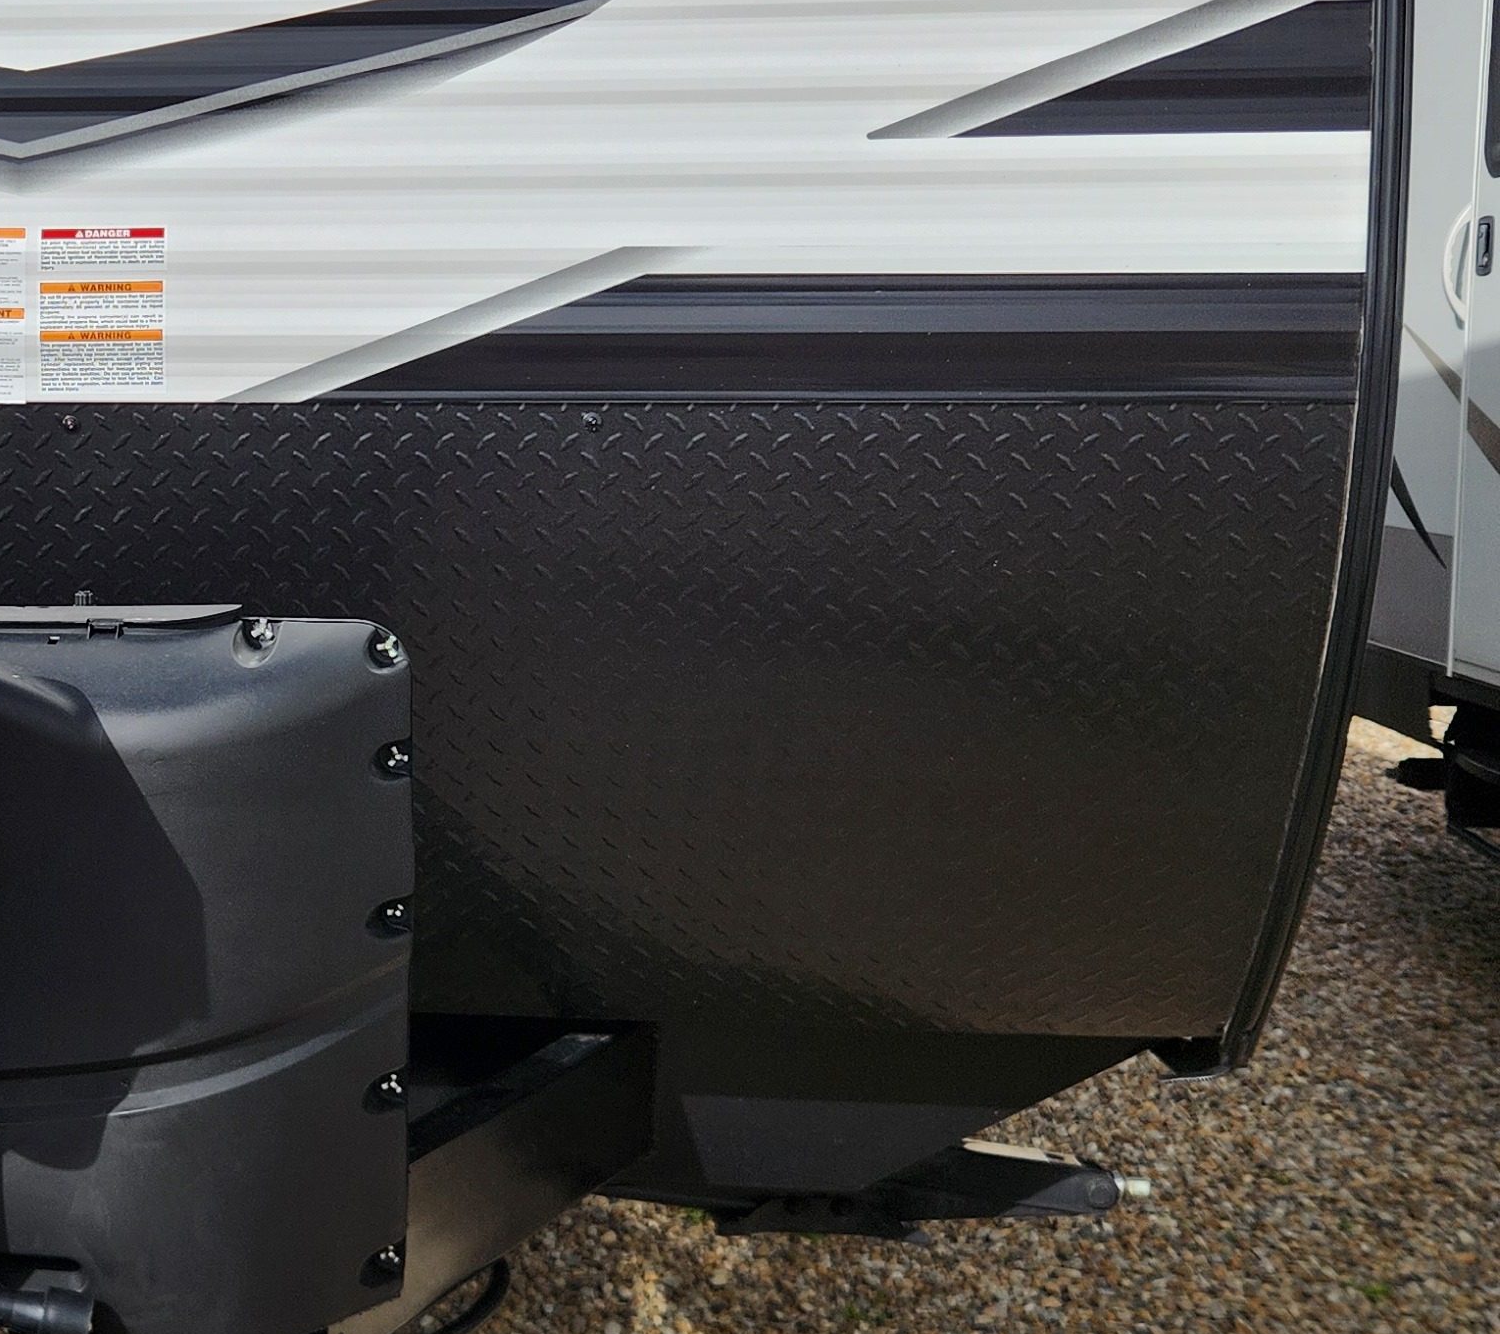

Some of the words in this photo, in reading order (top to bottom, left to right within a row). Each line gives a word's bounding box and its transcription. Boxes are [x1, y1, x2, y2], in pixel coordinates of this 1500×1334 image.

[85, 230, 131, 238] DANGER
[80, 284, 132, 292] WARNING
[80, 332, 131, 340] WARNING
